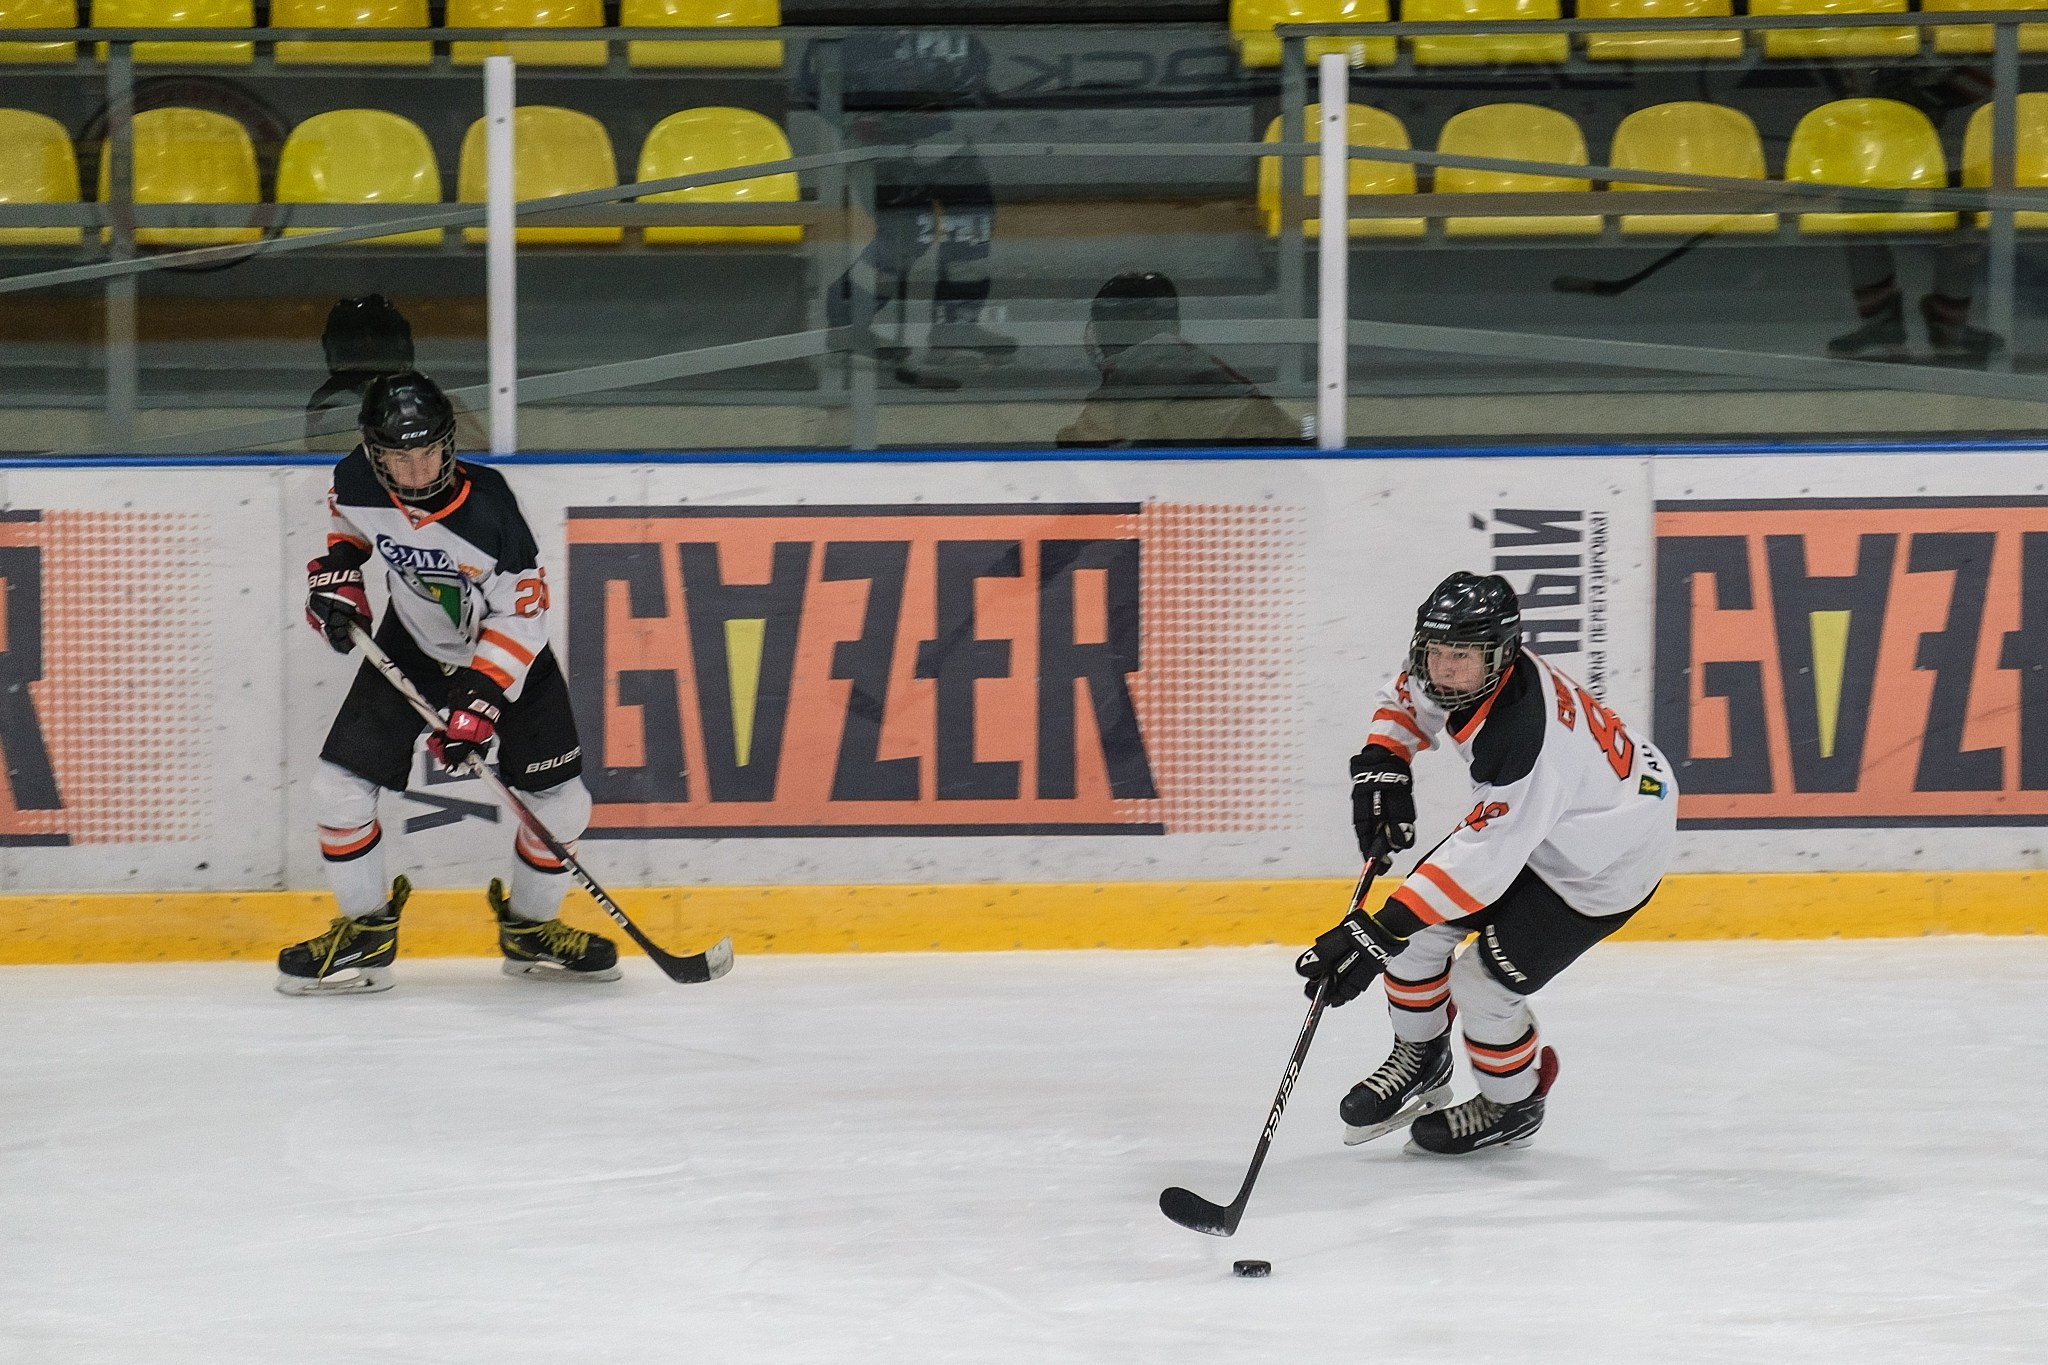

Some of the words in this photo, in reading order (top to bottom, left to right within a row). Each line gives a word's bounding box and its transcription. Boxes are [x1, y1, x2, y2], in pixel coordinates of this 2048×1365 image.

[309, 569, 363, 588] BAUE
[1470, 508, 1584, 656] НЫЙ
[568, 539, 1159, 804] GAZER
[1352, 771, 1410, 785] CHER
[1343, 920, 1394, 966] FISCH
[1485, 924, 1528, 983] BAUER
